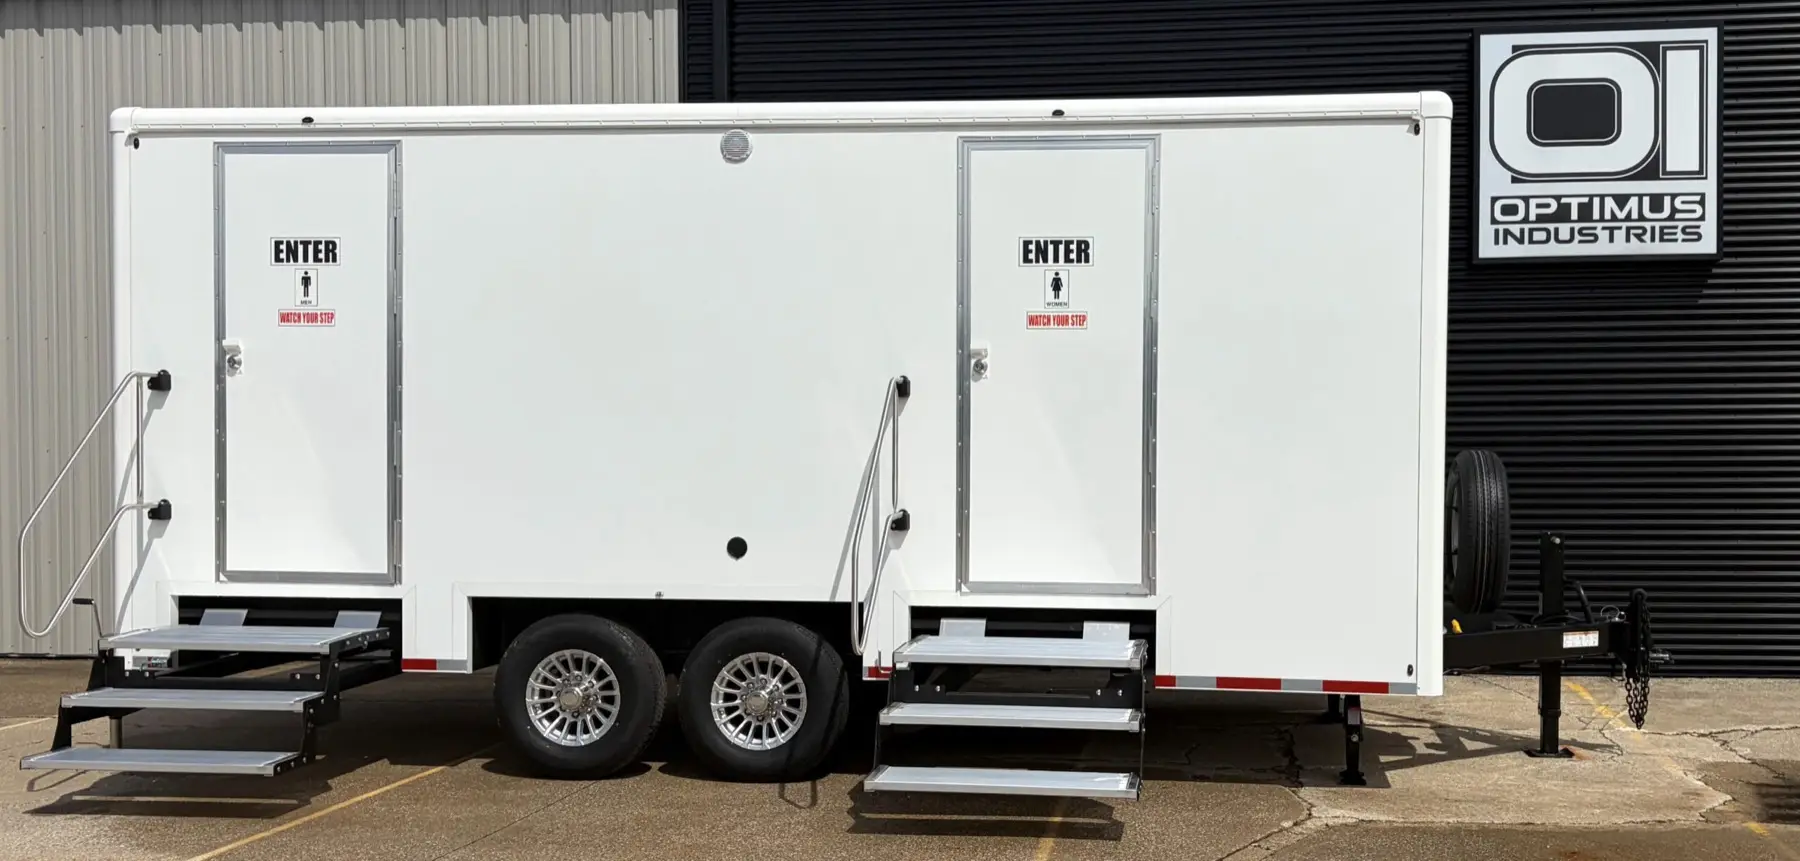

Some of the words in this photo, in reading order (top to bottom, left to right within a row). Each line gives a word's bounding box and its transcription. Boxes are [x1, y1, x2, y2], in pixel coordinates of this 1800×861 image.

[1493, 195, 1703, 222] OPTIMUS
[1493, 225, 1703, 246] INDUSTRIES
[274, 240, 337, 263] ENTER
[1022, 239, 1090, 264] ENTER
[280, 312, 301, 323] WATCH
[302, 312, 318, 323] YOUR
[319, 312, 335, 323] STEP
[1028, 314, 1051, 326] WATCH
[1052, 314, 1069, 326] YOUR
[1070, 314, 1087, 326] STEP
